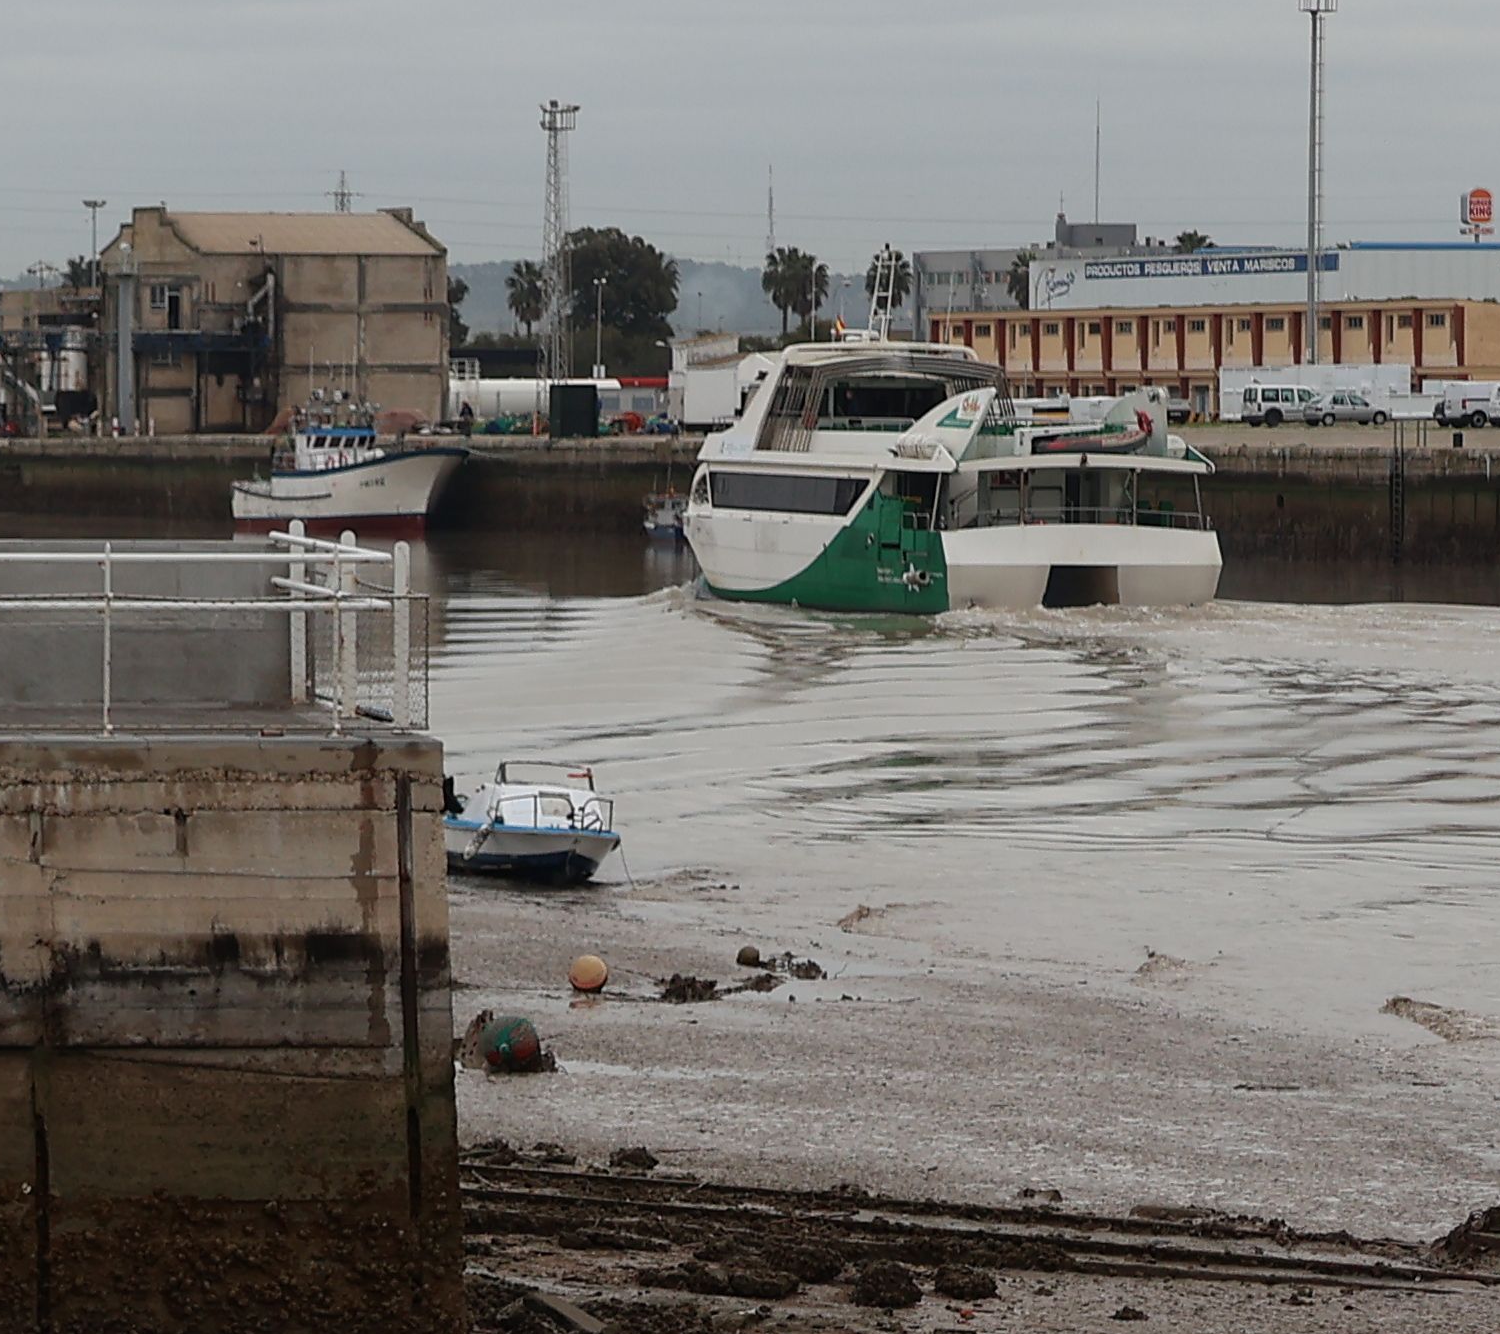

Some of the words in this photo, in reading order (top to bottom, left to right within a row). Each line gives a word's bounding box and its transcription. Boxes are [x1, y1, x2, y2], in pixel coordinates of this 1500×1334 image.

[1470, 205, 1492, 216] KING
[1085, 263, 1141, 278] PRODUCTOS
[1207, 258, 1240, 273] VENTA
